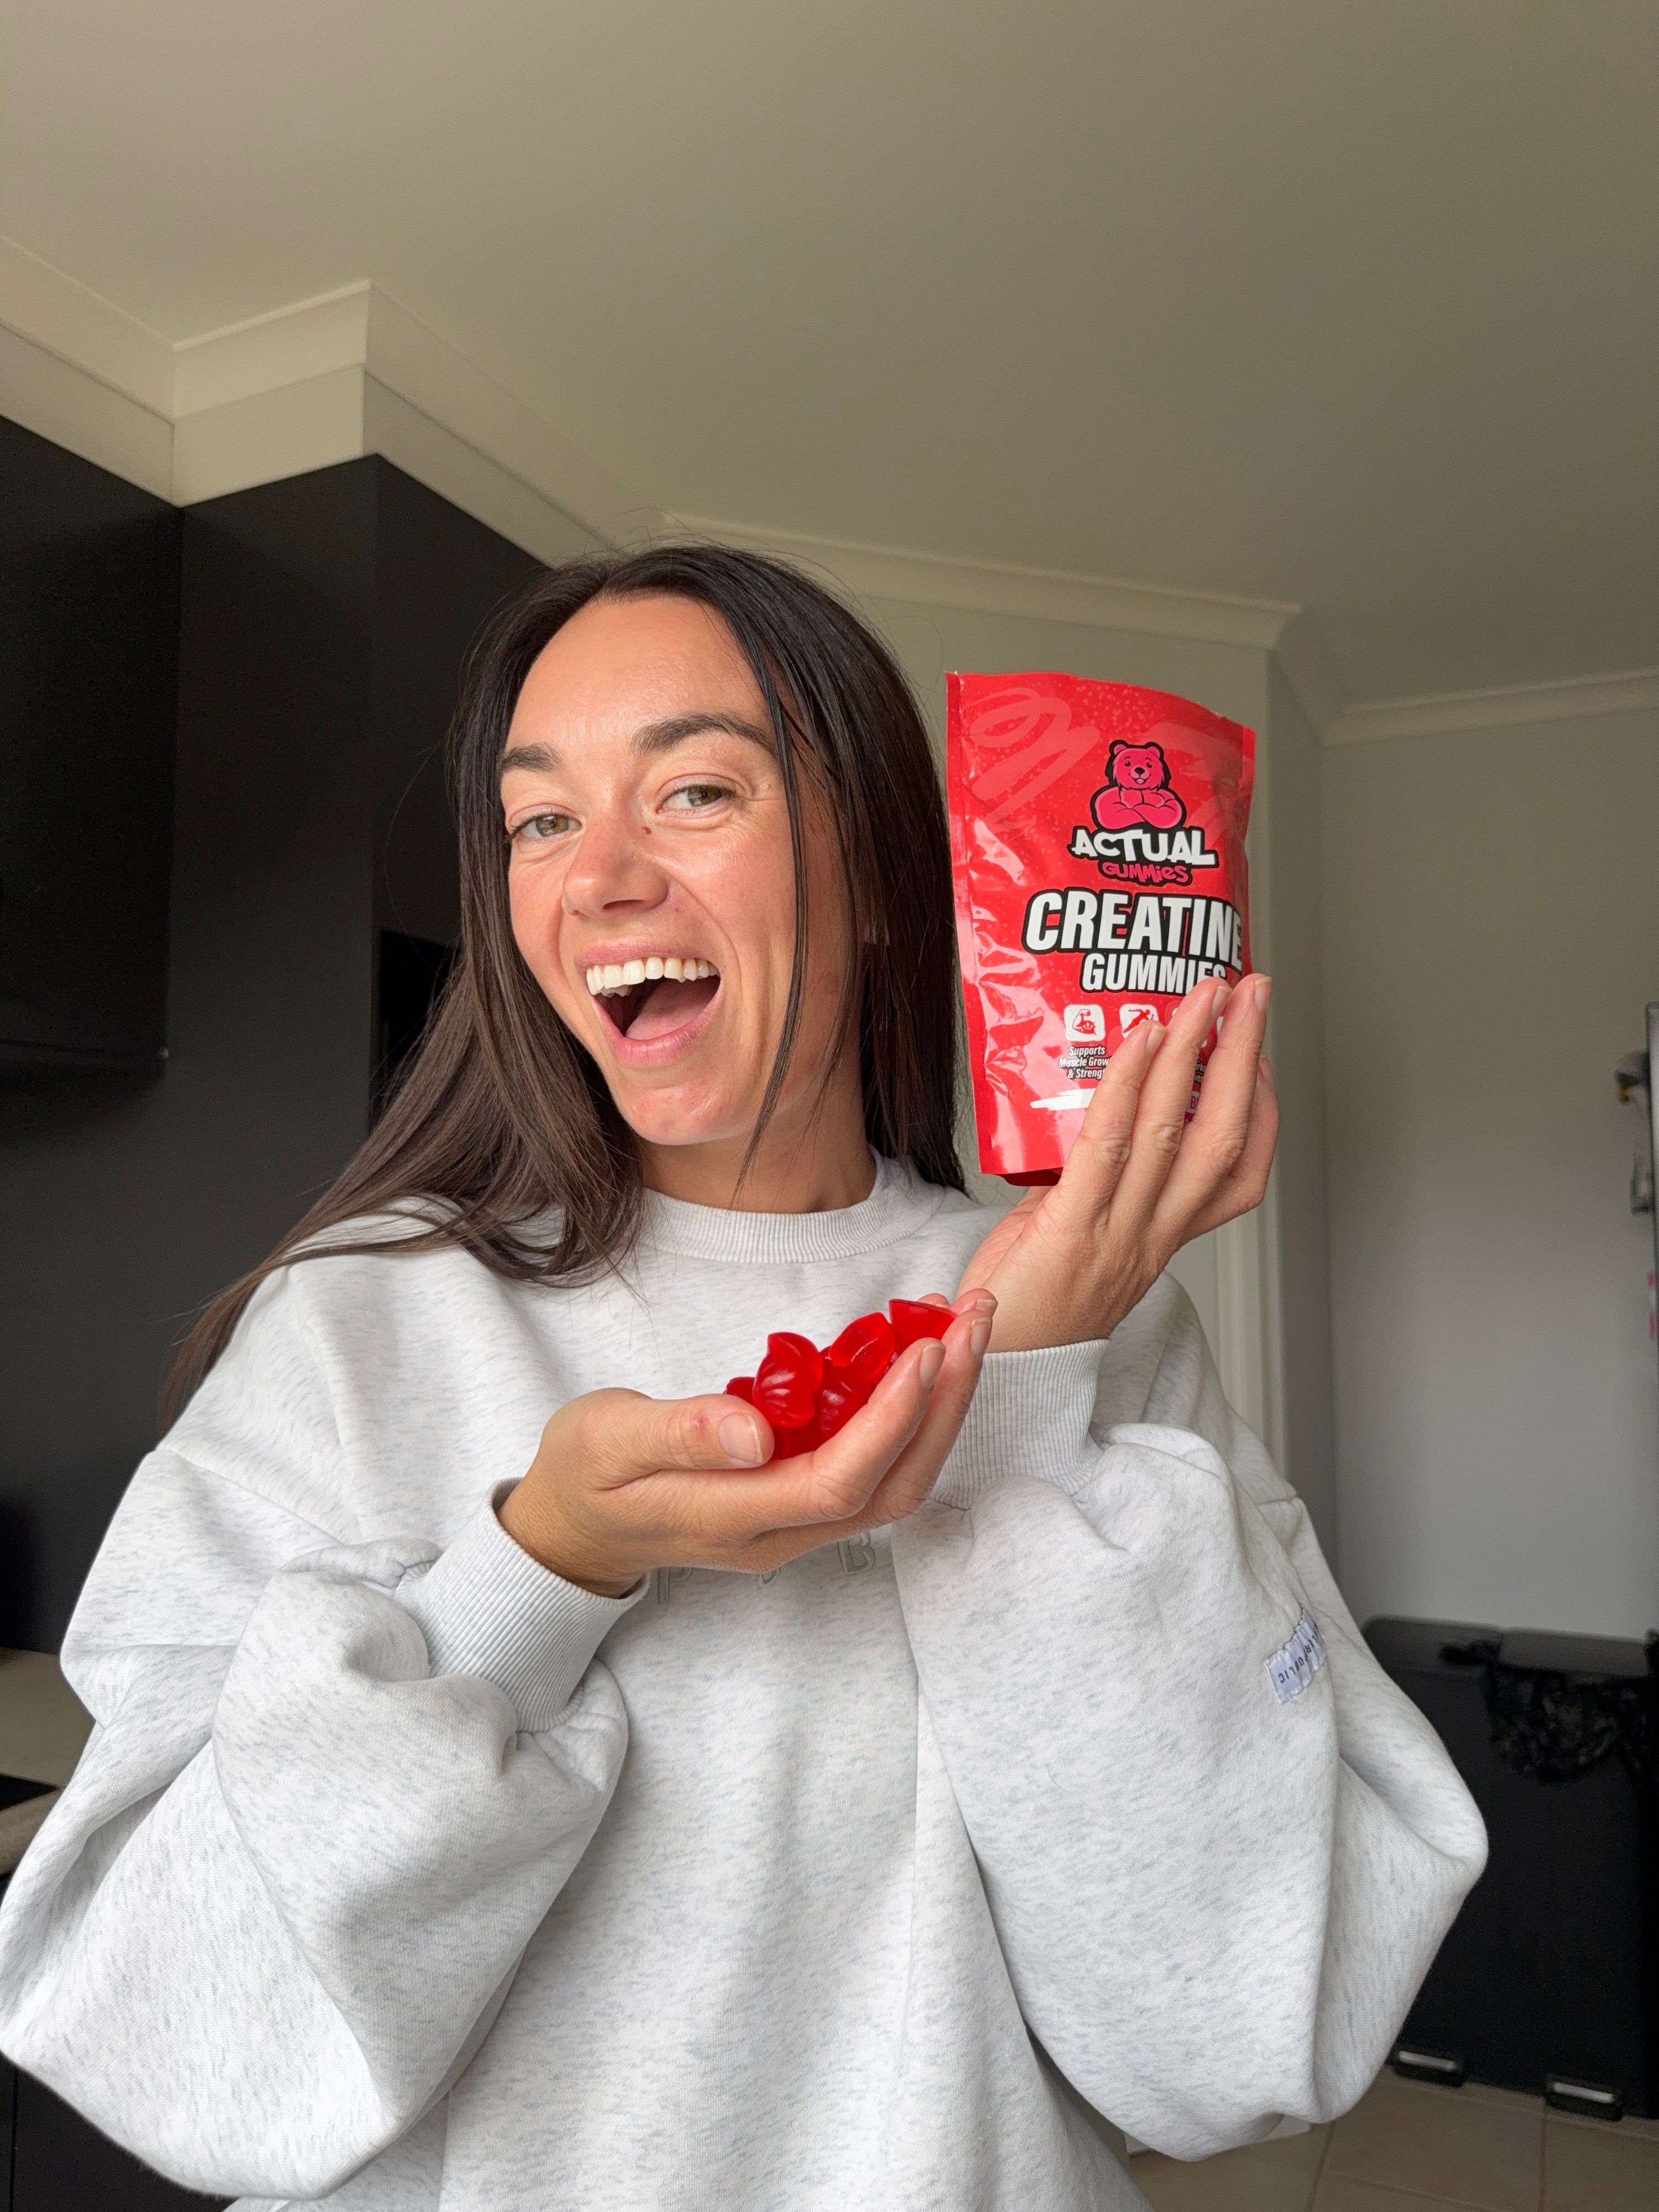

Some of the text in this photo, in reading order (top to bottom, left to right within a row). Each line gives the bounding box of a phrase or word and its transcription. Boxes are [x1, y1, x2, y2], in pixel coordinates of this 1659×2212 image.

[1071, 830, 1215, 865] ACTUAL
[1026, 890, 1241, 971] CREATINE
[1069, 1046, 1105, 1057] Supports
[1058, 1057, 1110, 1068] Muscle Grow
[1067, 1069, 1074, 1078] &
